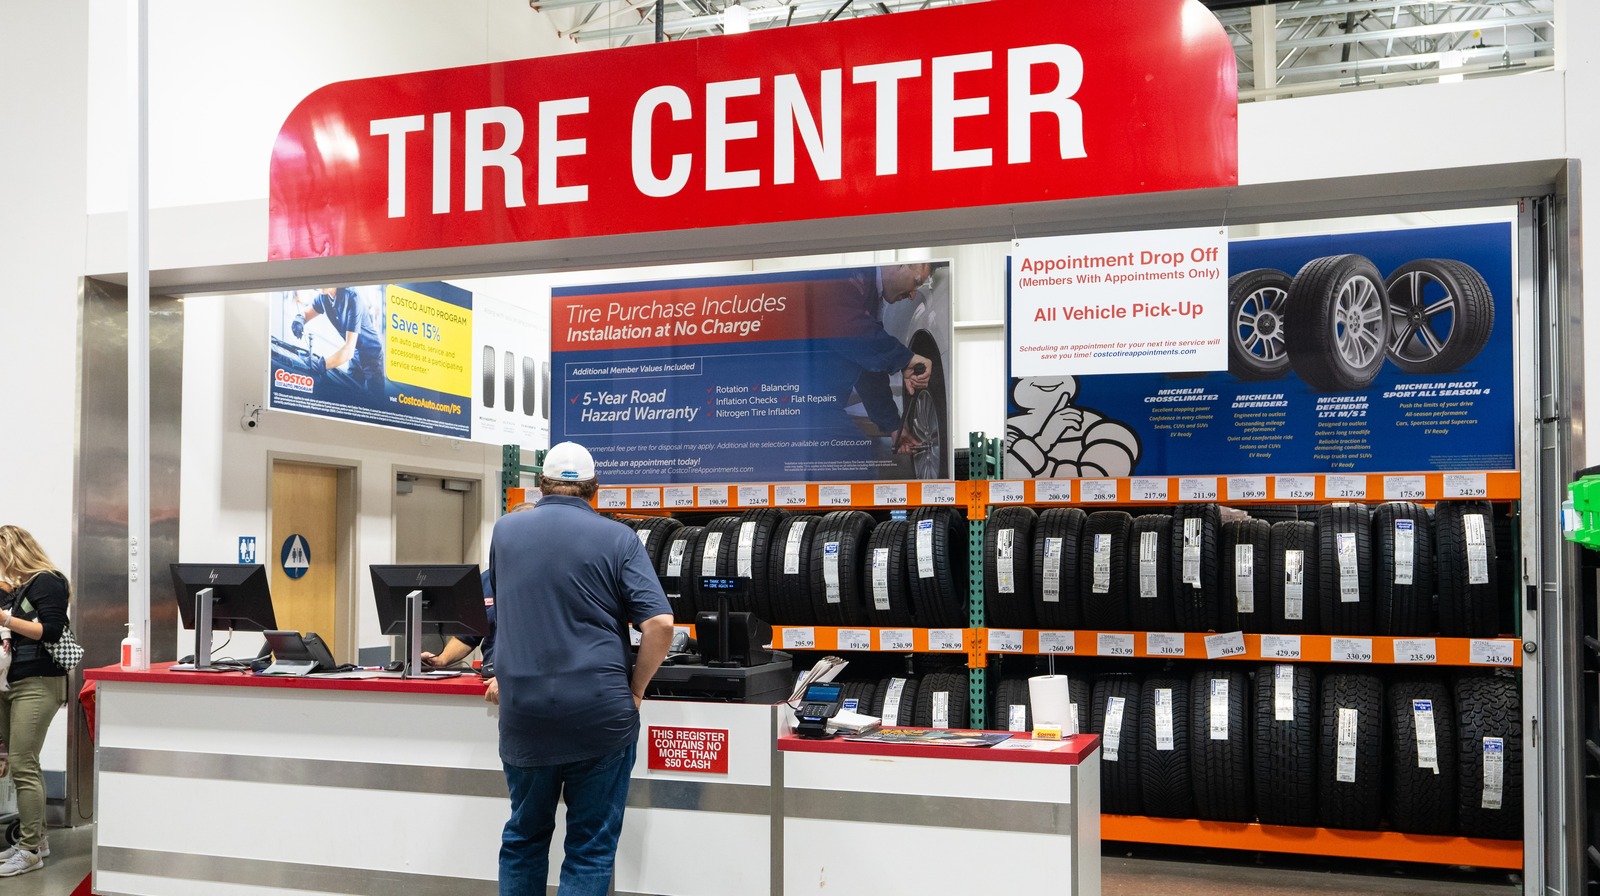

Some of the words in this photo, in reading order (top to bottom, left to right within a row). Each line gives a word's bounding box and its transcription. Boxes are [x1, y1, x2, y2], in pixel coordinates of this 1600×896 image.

[370, 97, 590, 218] TIRE
[631, 43, 1088, 198] CENTER
[1021, 255, 1134, 274] Appointment
[1140, 250, 1185, 266] Drop
[1191, 247, 1218, 263] Off
[1019, 276, 1073, 289] (Members
[1076, 275, 1101, 284] With
[1105, 271, 1185, 284] Appointments
[1188, 268, 1220, 279] Only)
[391, 295, 417, 311] COSTCO
[419, 303, 435, 316] AUTO
[436, 310, 467, 326] PROGRAM
[566, 305, 601, 323] Tire
[607, 301, 696, 322] Purchase
[701, 293, 786, 317] Includes
[1034, 307, 1056, 321] All
[1063, 304, 1127, 321] Vehicle
[1132, 301, 1203, 319] Pick-Up
[391, 313, 418, 335] Save
[422, 322, 441, 342] 15%
[567, 323, 651, 342] Installation
[654, 324, 670, 337] at
[674, 321, 698, 336] No
[399, 339, 411, 347] auto
[412, 341, 427, 352] parts,
[427, 345, 444, 356] service
[446, 349, 455, 358] and
[1019, 344, 1058, 353] Scheduling
[1070, 343, 1115, 351] appointment
[1040, 352, 1057, 360] save
[1059, 352, 1072, 360] you
[1093, 348, 1197, 358] costcotireappointments.com
[391, 349, 421, 362] accessories
[432, 357, 463, 372] participating
[572, 367, 609, 376] Additional
[610, 365, 639, 374] Member
[640, 364, 663, 373] Values
[664, 363, 695, 371] Included
[716, 385, 748, 394] Rotation
[761, 384, 800, 393] Balancing
[1395, 382, 1447, 390] MICHELIN
[1448, 381, 1478, 389] PILOT
[582, 392, 627, 405] 5-Year
[631, 389, 666, 404] Road
[1144, 394, 1219, 402] CROSSCLIMATE2
[1383, 390, 1416, 398] SPORT
[399, 394, 461, 414] CostcoAuto.com/PS
[716, 398, 747, 406] Inflation
[749, 396, 778, 404] Checks
[807, 394, 837, 403] Repairs
[581, 407, 631, 422] Hazard
[716, 410, 749, 418] Nitrogen
[767, 408, 800, 416] Inflation
[1338, 410, 1358, 418] M/S
[658, 444, 682, 452] disposal
[620, 459, 628, 467] an
[630, 458, 675, 468] appointment
[677, 457, 701, 466] today!
[667, 466, 754, 475] CostcoTireAppointments.com
[1001, 643, 1022, 651] 236.99
[1111, 647, 1133, 655] 253.99
[1222, 646, 1244, 655] 304.99
[1346, 653, 1371, 661] 330.99
[652, 730, 673, 739] THIS
[676, 731, 725, 741] REGISTER
[655, 739, 704, 750] CONTAINS
[706, 742, 721, 751] NO
[659, 749, 688, 758] MORE
[690, 750, 717, 760] THAN
[665, 758, 681, 768] $50
[684, 759, 711, 769] CASH
